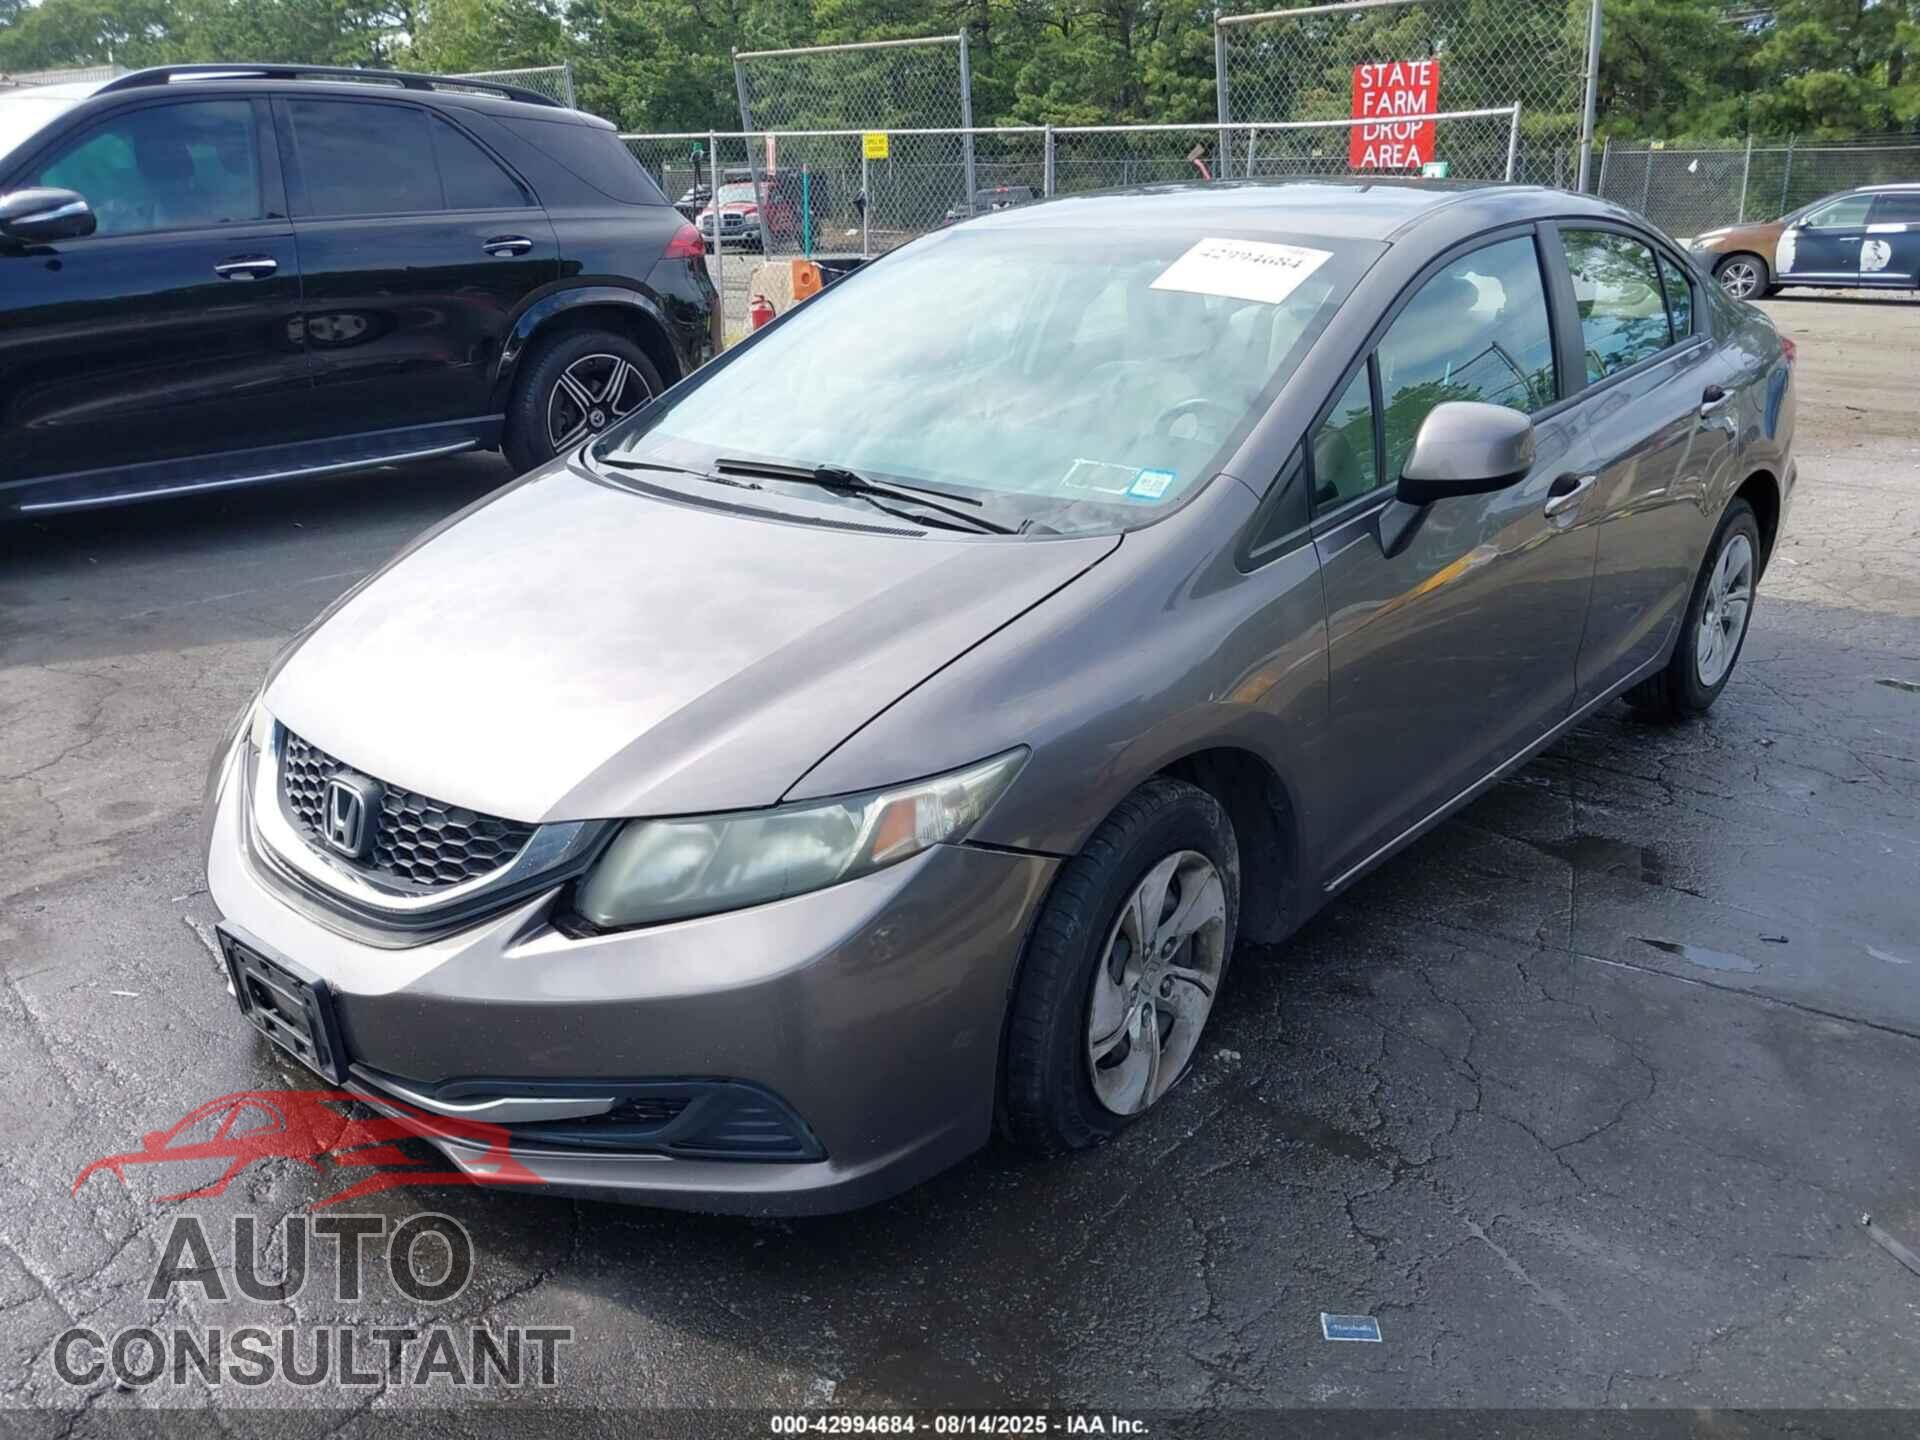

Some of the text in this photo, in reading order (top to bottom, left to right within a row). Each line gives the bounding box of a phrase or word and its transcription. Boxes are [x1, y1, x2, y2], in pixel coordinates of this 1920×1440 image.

[1361, 61, 1432, 88] STATE
[1363, 89, 1427, 115] FARM
[1363, 121, 1423, 140] DROP
[1360, 143, 1422, 168] AREA
